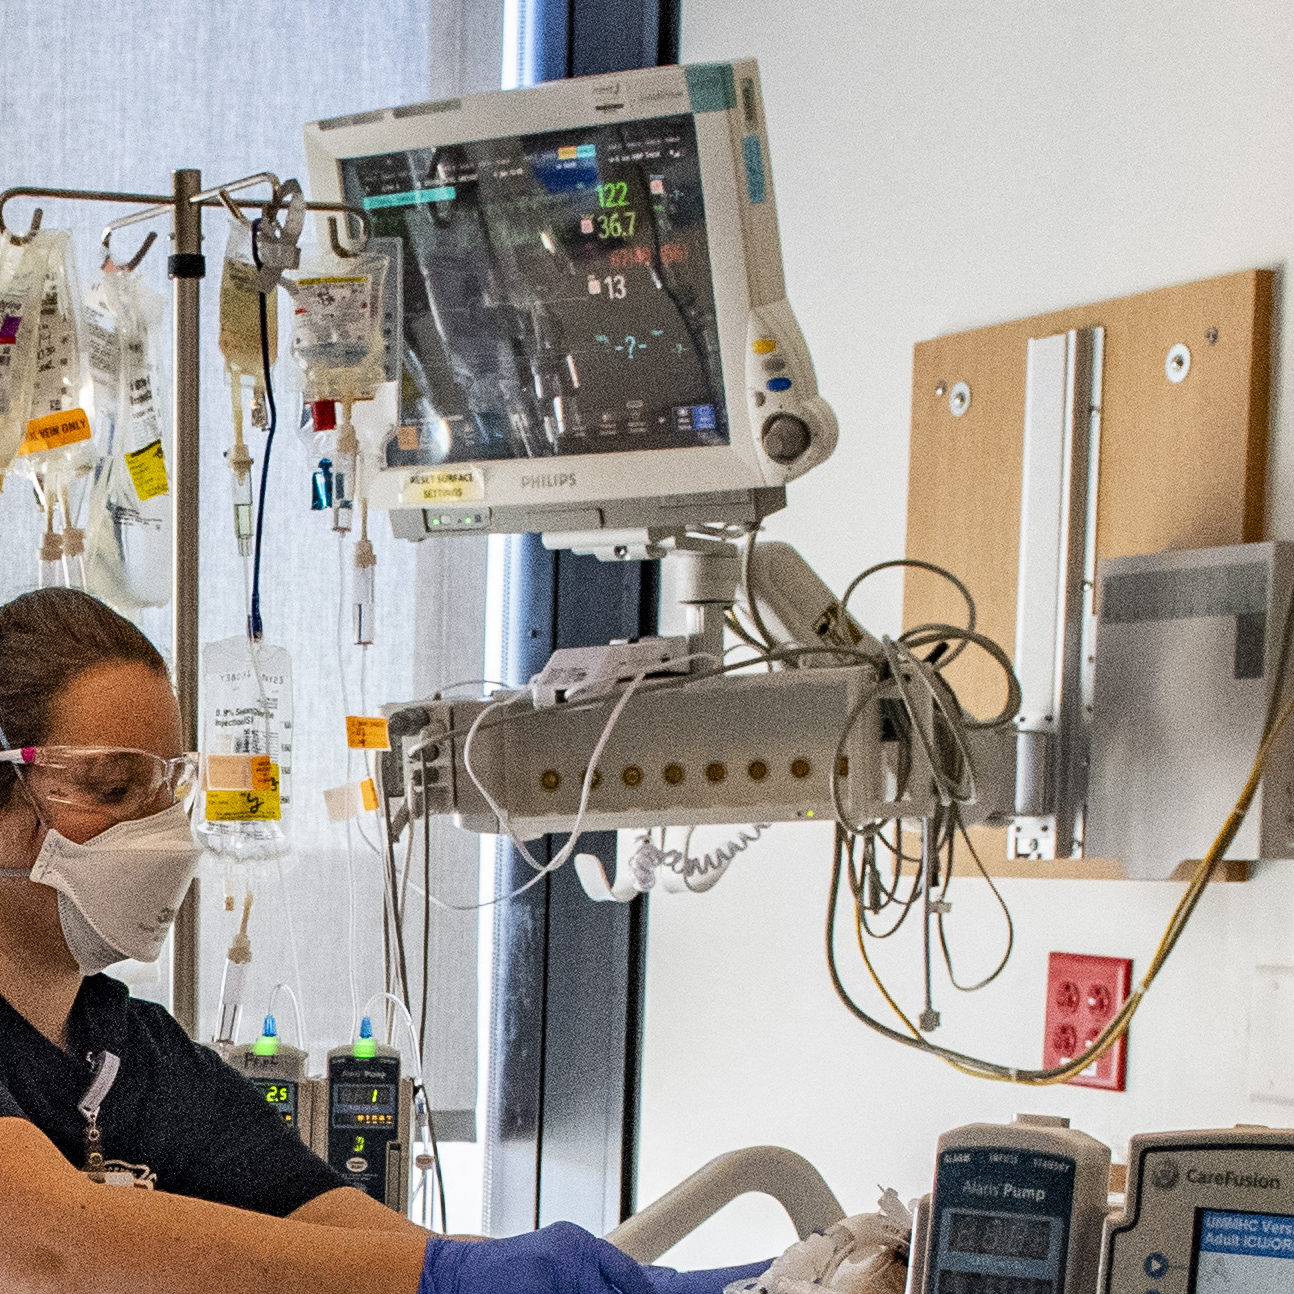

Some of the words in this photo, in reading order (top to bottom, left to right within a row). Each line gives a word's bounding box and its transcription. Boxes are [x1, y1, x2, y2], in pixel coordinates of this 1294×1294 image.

[597, 182, 629, 208] 122
[598, 211, 636, 239] 36.7
[604, 275, 627, 299] 13
[61, 419, 86, 434] ONLY
[437, 472, 473, 483] SURFACE
[521, 473, 577, 489] PHILIPS
[266, 1085, 287, 1103] 2.5
[371, 1089, 378, 1103] 1
[1186, 1168, 1281, 1190] CareFusion
[962, 1180, 1000, 1198] Alaris
[1003, 1183, 1046, 1202] Pump
[1205, 1232, 1239, 1247] Adult
